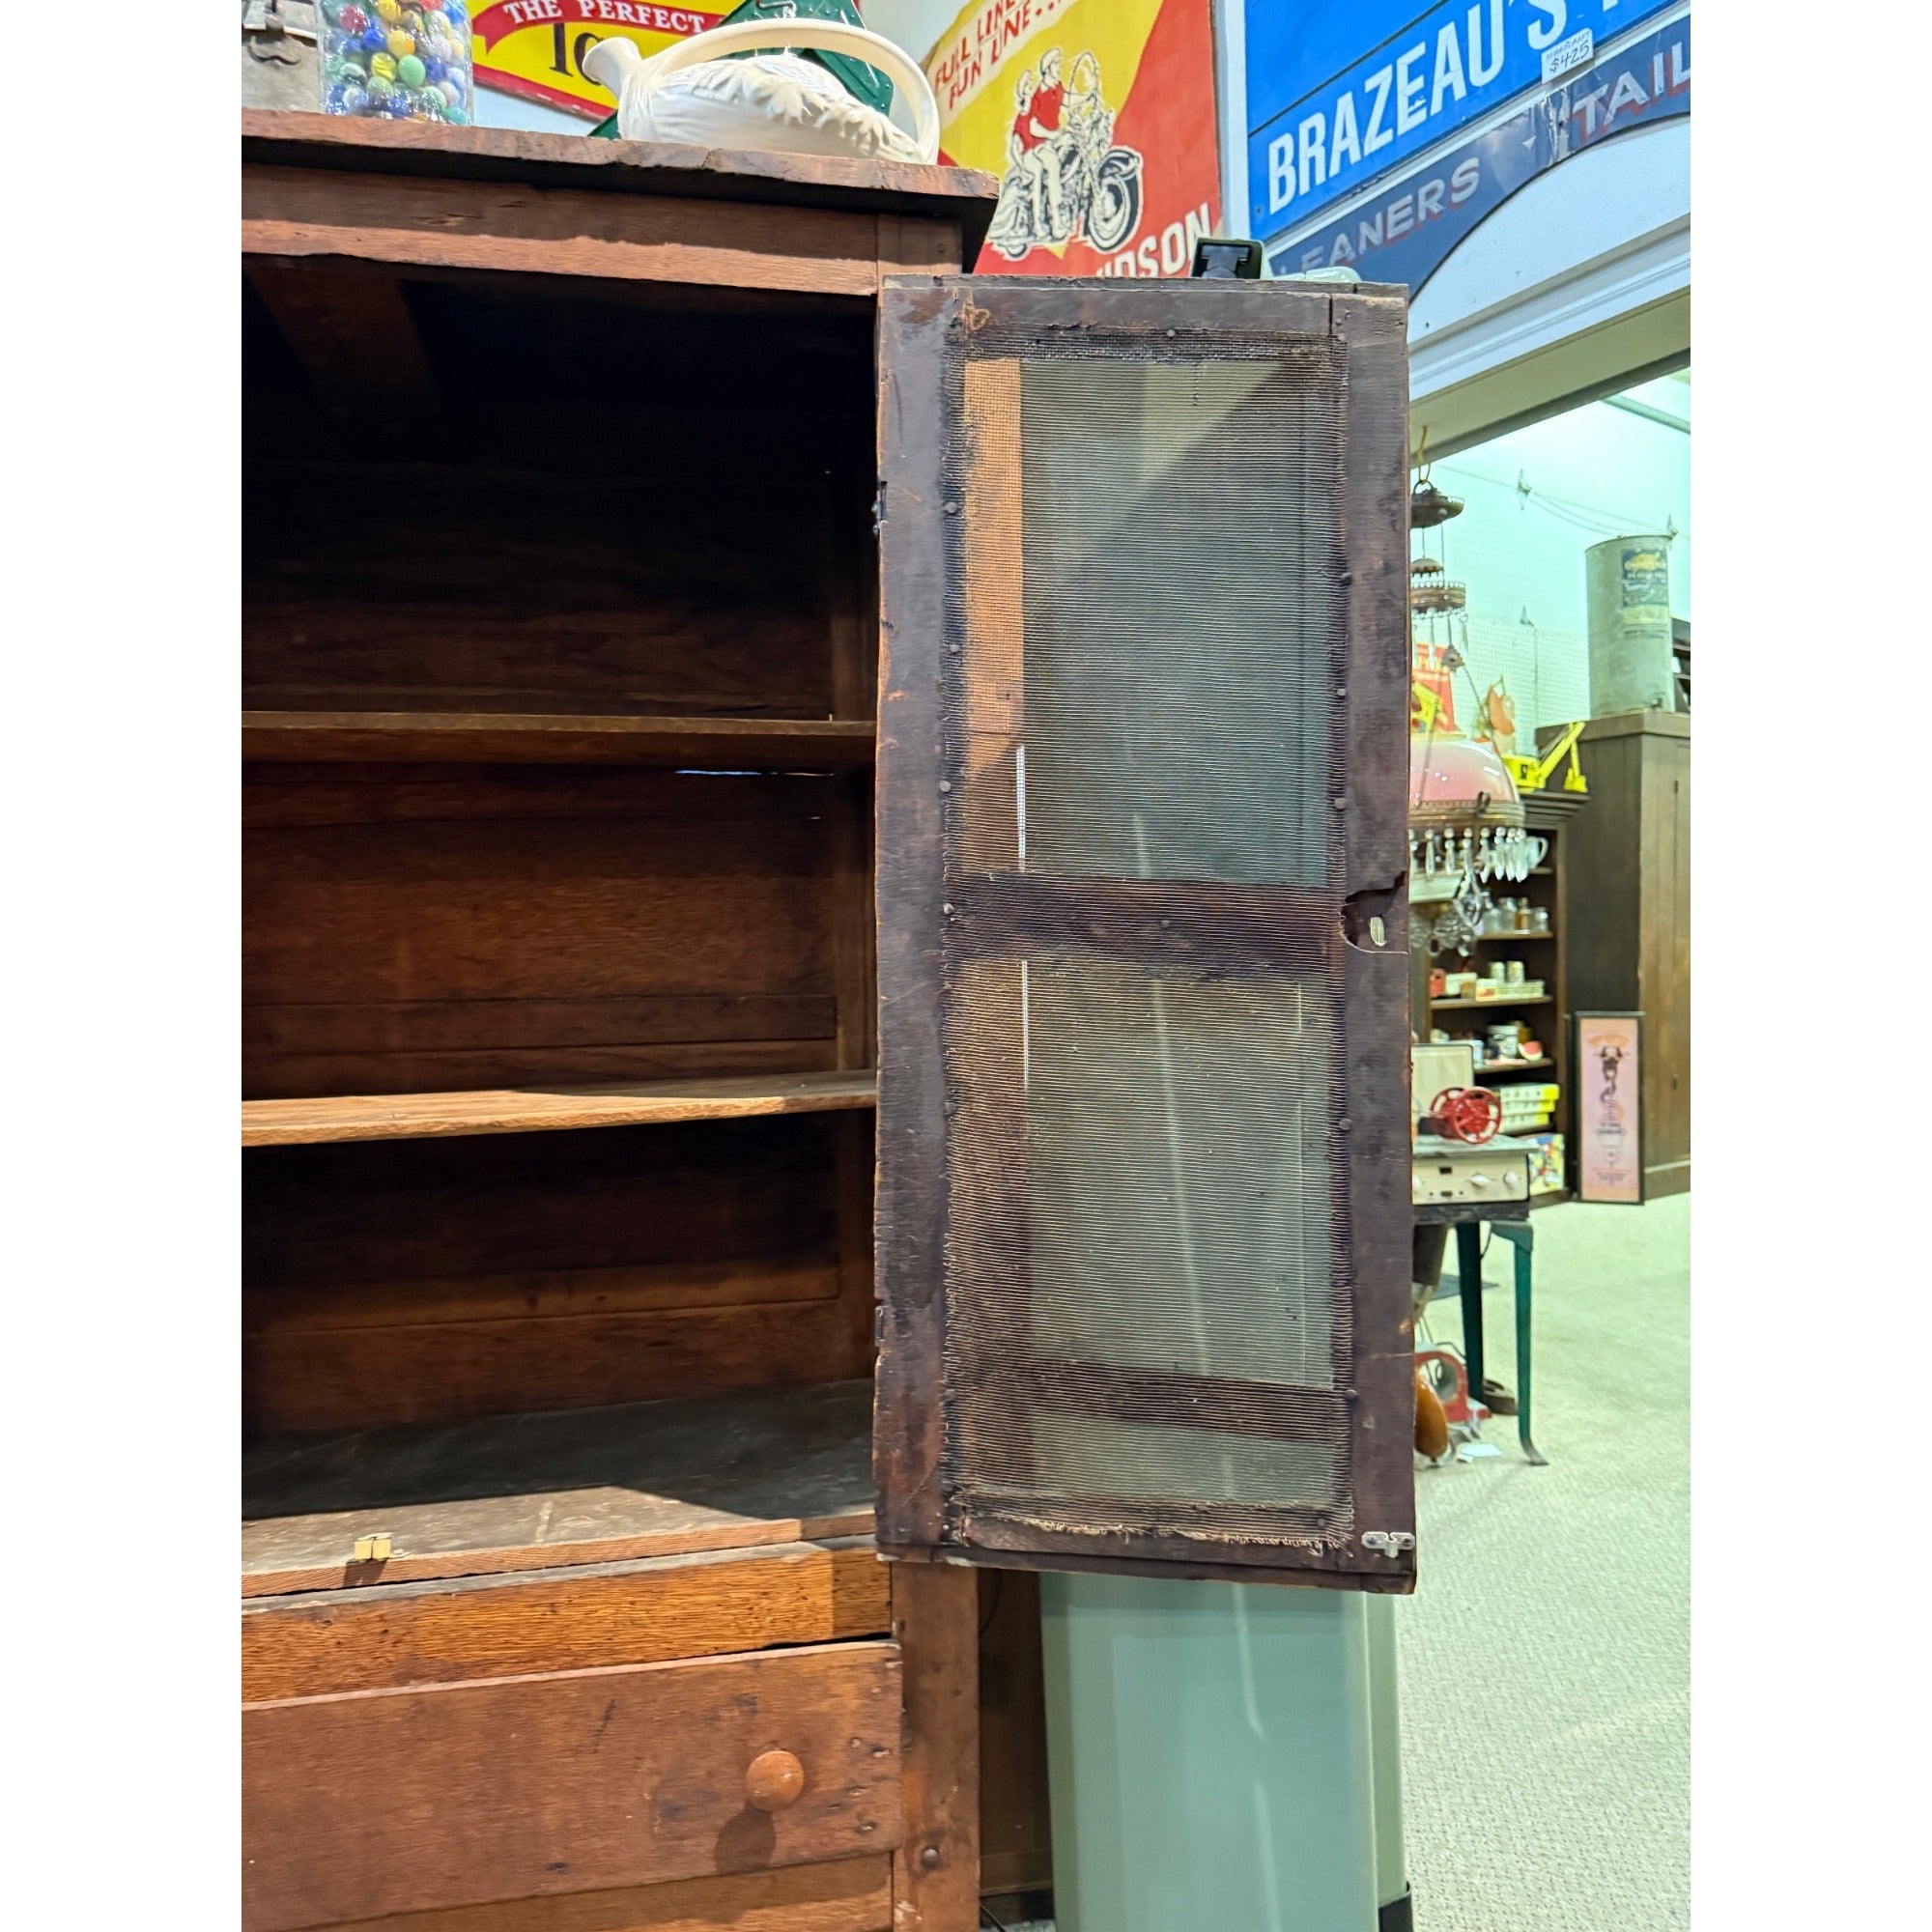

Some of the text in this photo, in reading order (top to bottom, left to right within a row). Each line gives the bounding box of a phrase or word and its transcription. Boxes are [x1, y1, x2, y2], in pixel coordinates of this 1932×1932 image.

[503, 0, 705, 34] THE PERFECT
[934, 36, 971, 98] FULL
[949, 50, 982, 111] FUN
[1548, 39, 1590, 74] $425
[1280, 156, 1481, 274] EANERS
